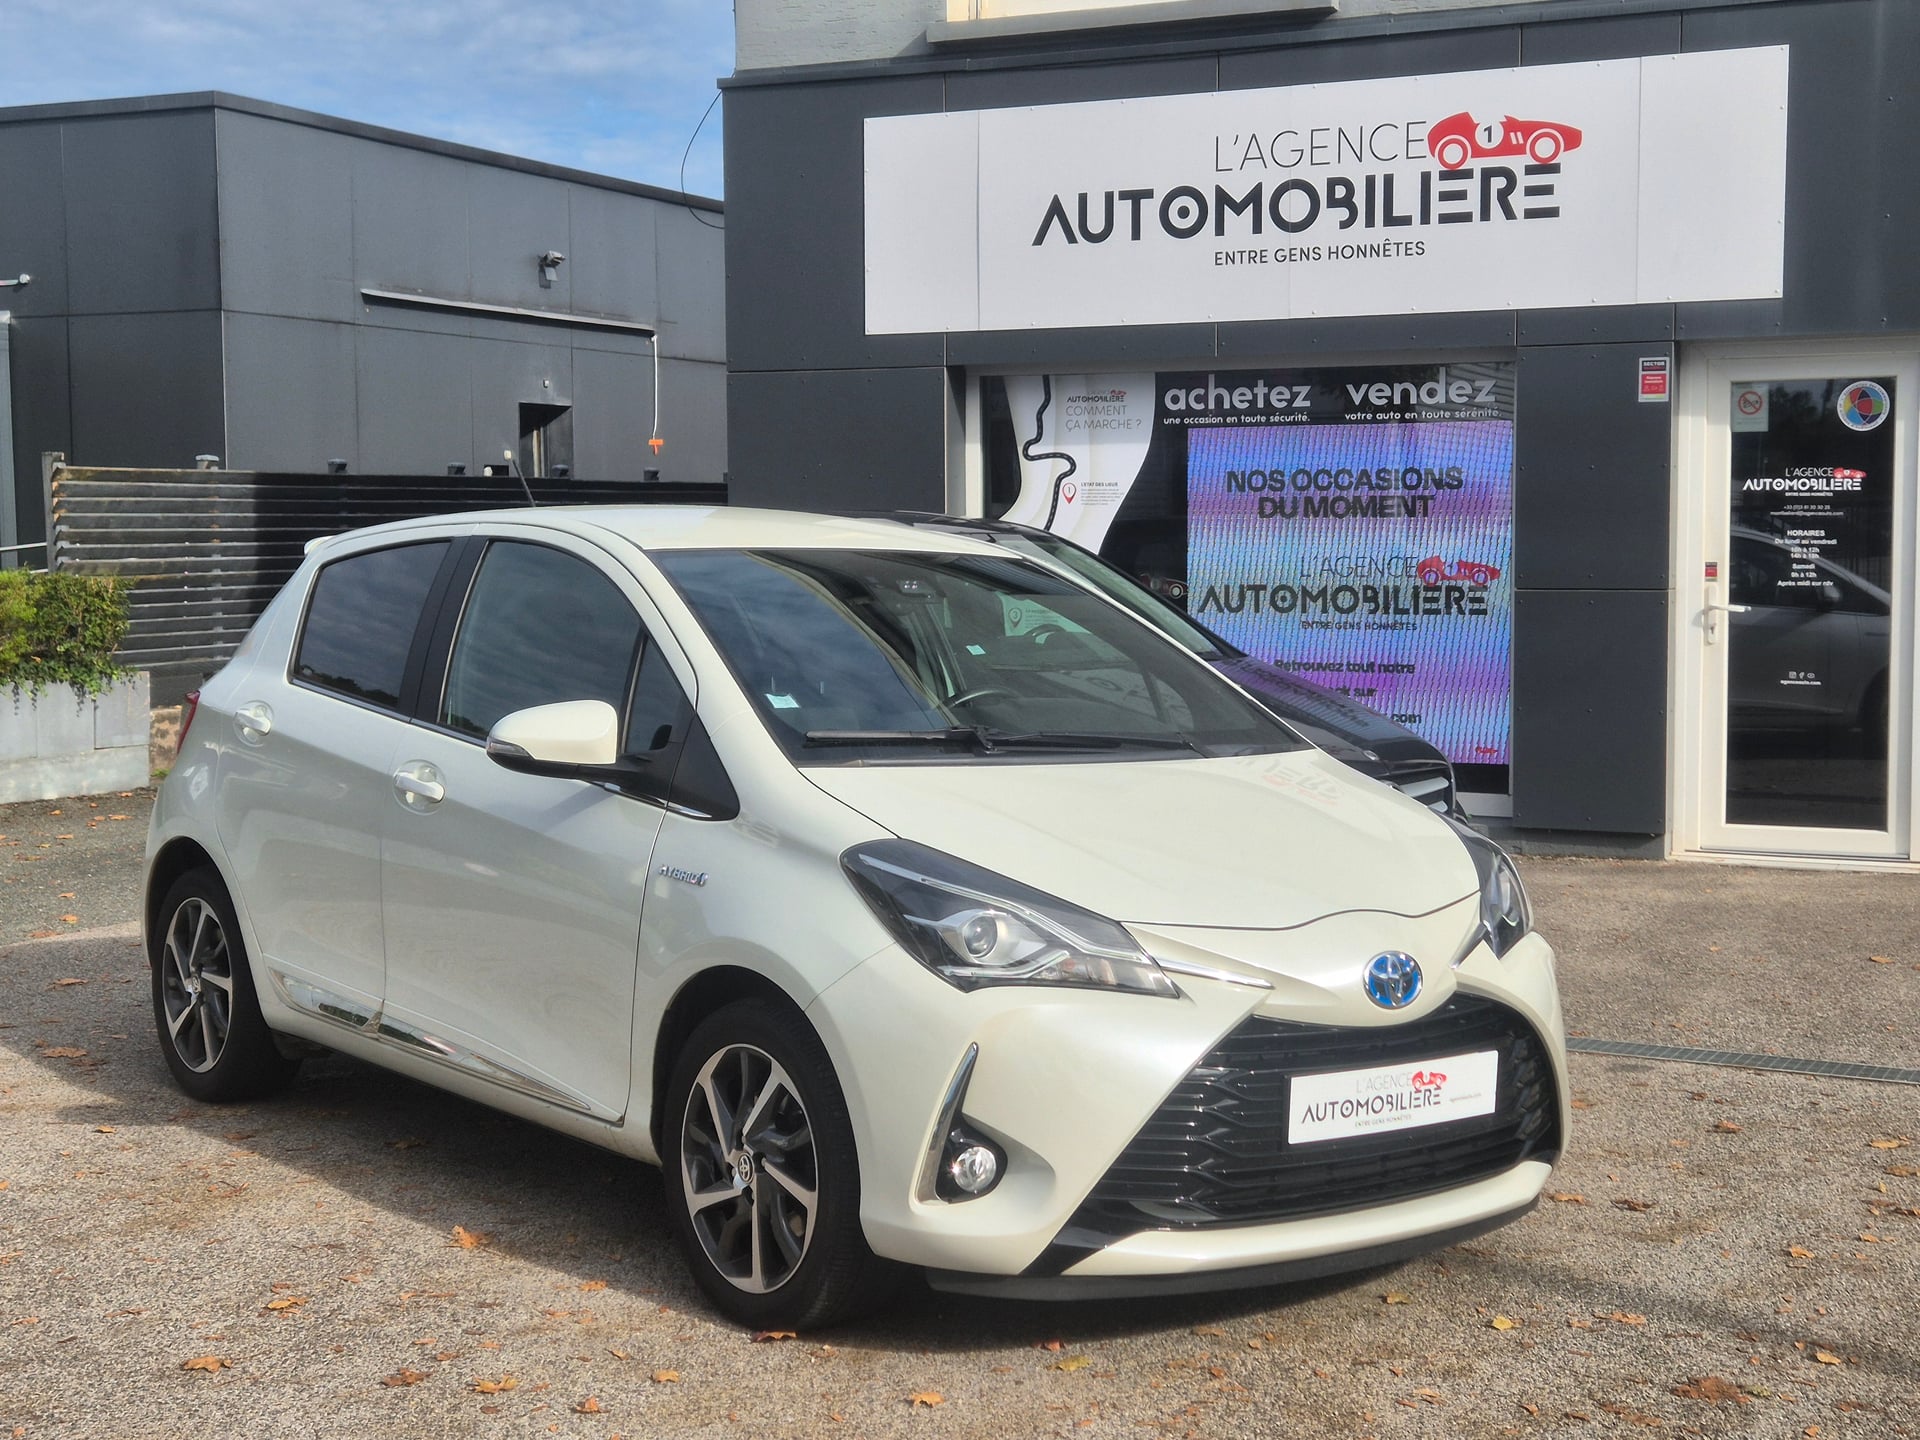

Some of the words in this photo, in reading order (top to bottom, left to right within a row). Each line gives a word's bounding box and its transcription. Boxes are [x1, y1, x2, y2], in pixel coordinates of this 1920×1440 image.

[1215, 121, 1427, 172] L'AGENCE
[1214, 250, 1268, 266] ENTRE
[1274, 246, 1321, 263] GENS
[1328, 238, 1425, 261] HONNÊTES
[1164, 373, 1311, 411] achetez
[1346, 366, 1496, 406] vendez
[1065, 405, 1128, 416] COMMENT
[1345, 411, 1373, 421] votre
[1376, 411, 1401, 420] auto
[1404, 412, 1418, 420] en
[1421, 410, 1450, 419] toute
[1163, 417, 1181, 425] une
[1184, 414, 1223, 424] occasion
[1226, 416, 1237, 424] en
[1241, 414, 1266, 423] toute
[1269, 411, 1311, 423] sécurité.
[1065, 419, 1081, 432] ÇA
[1084, 419, 1133, 430] MARCHE
[1785, 467, 1834, 477] L'AGENCE
[1227, 469, 1286, 493] NOS
[1290, 466, 1465, 492] OCCASIONS
[1258, 496, 1298, 519] DU
[1303, 495, 1435, 518] MOMENT
[1300, 556, 1417, 578] L'AGENCE
[1301, 621, 1332, 630] ENTRE
[1335, 622, 1361, 630] GENS
[1346, 661, 1376, 673] tout
[1378, 662, 1416, 674] notre
[1353, 688, 1377, 697] sur
